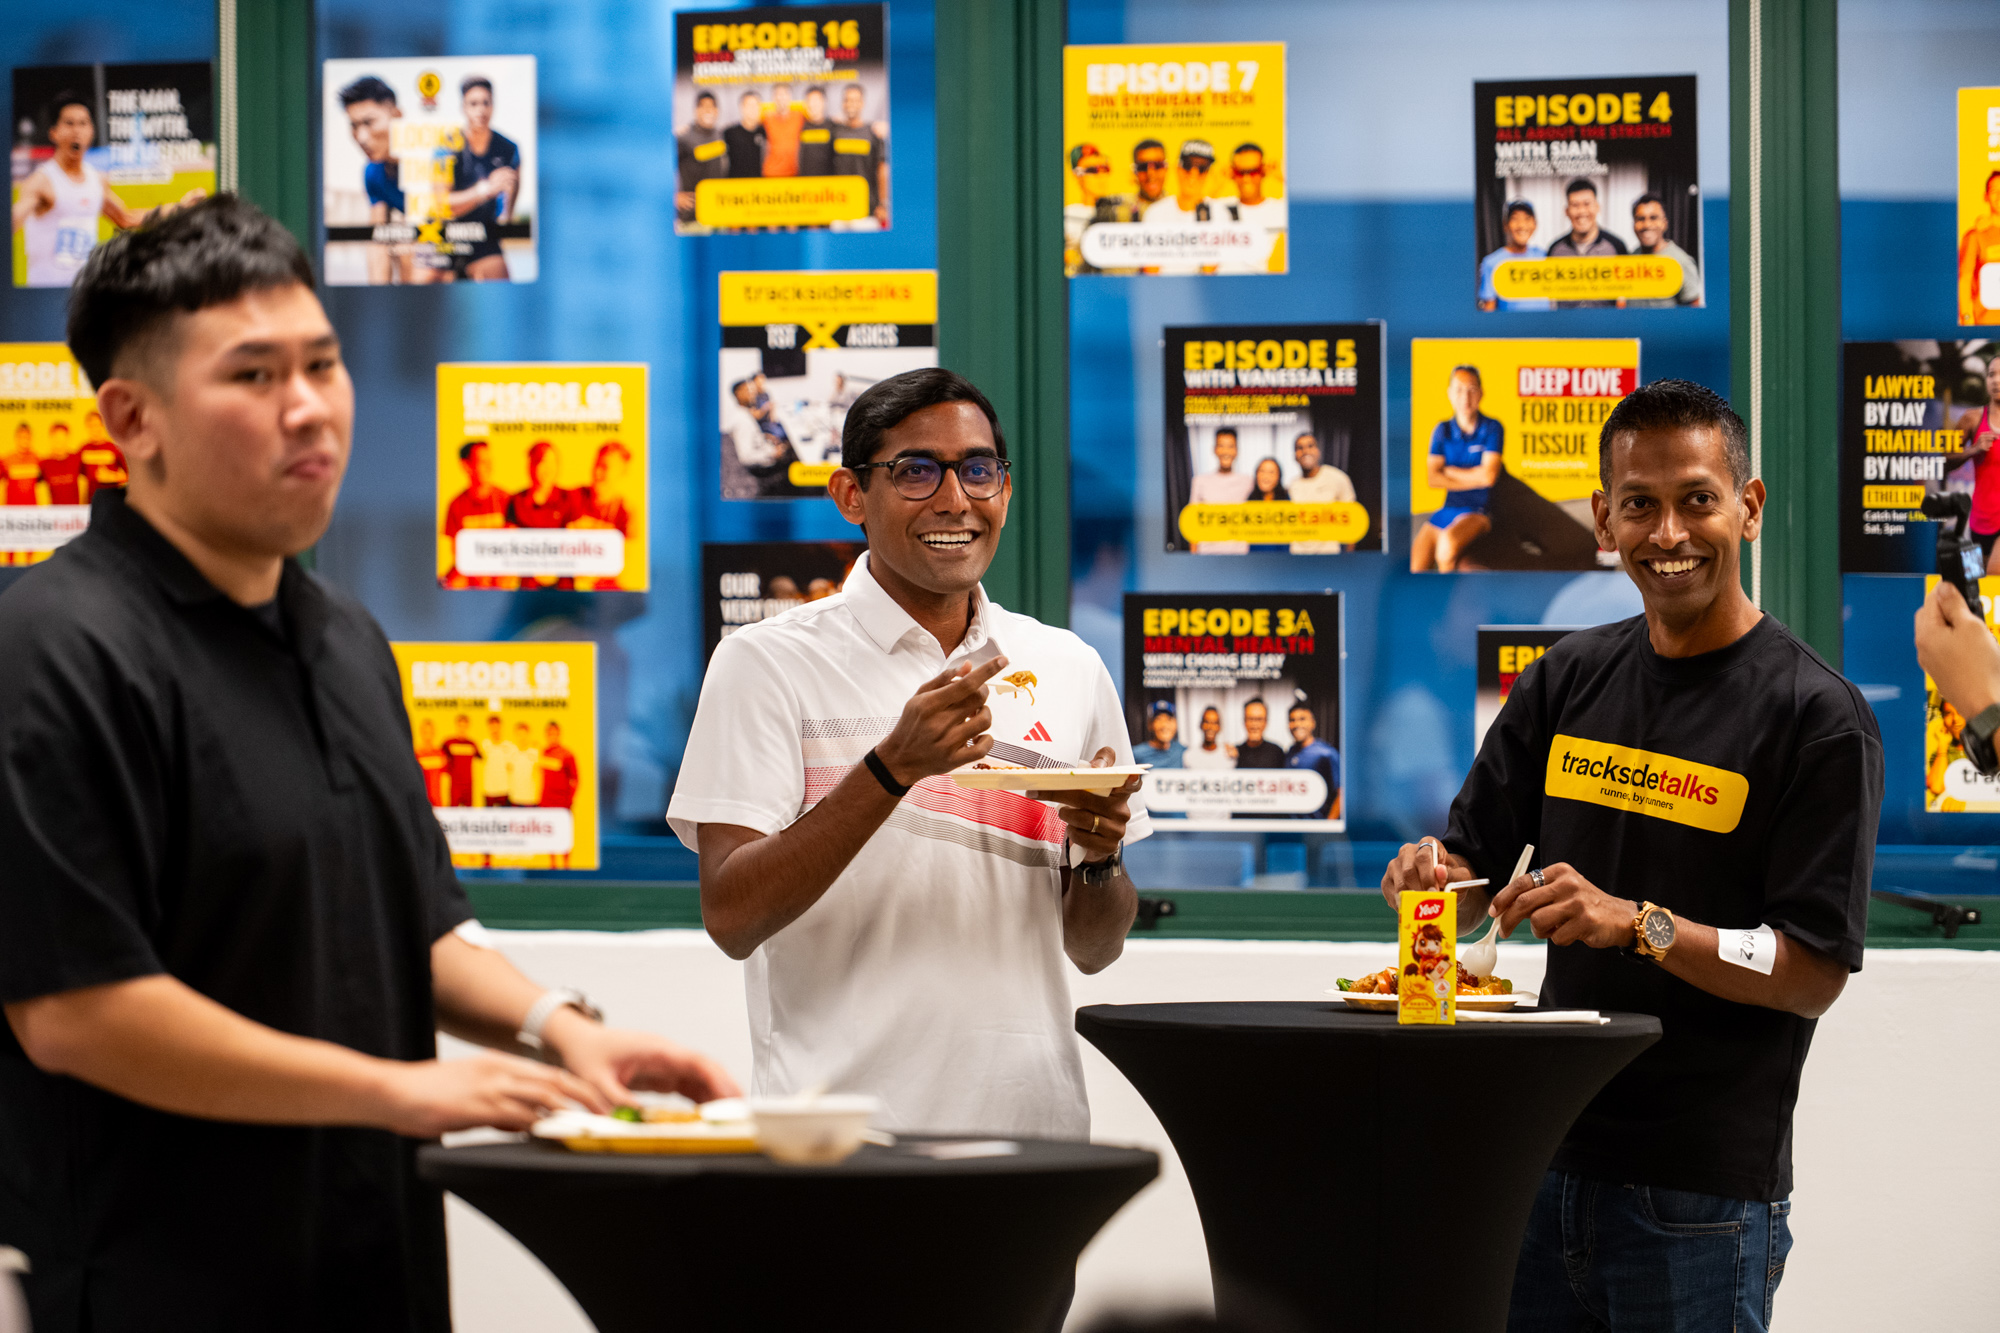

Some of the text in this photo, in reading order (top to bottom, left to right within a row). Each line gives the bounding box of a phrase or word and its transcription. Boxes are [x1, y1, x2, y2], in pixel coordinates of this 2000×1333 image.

[692, 19, 860, 53] EPISODE 16
[1086, 60, 1260, 95] EPISODE 7
[1494, 91, 1672, 128] EPISODE 4
[1495, 123, 1672, 141] ALL ABOUT THE STRETCH
[1495, 140, 1598, 158] WITH SIAN
[1099, 230, 1251, 250] tracksidetalks
[1509, 264, 1666, 284] tracksidetalks
[744, 282, 913, 302] tracksidetalks
[846, 323, 899, 348] ASICS
[1184, 338, 1358, 370] EPISODE 5
[1184, 366, 1358, 388] WITH VANESSA LEE
[1519, 367, 1623, 396] DEEP LOVE
[1863, 374, 1936, 400] LAWYER
[462, 382, 582, 409] EPISODE
[1520, 401, 1610, 424] FOR DEEP
[1863, 402, 1927, 426] BY DAY
[1521, 432, 1590, 456] TISSUE
[1863, 429, 1964, 453] TRIATHLETE
[1863, 456, 1947, 481] BY NIGHT
[1197, 508, 1351, 528] tracksidetalks
[719, 572, 761, 598] OUR
[1143, 608, 1316, 637] EPISODE 3A
[1143, 636, 1315, 655] MENTAL HEALTH
[1143, 653, 1184, 669] WITH
[1185, 653, 1240, 670] CHONG
[1259, 653, 1286, 670] JAY
[411, 661, 531, 689] EPISODE
[1155, 777, 1308, 797] tracksidetalks
[1632, 791, 1646, 805] by
[1645, 796, 1674, 811] runners
[1418, 903, 1441, 919] Yeo's
